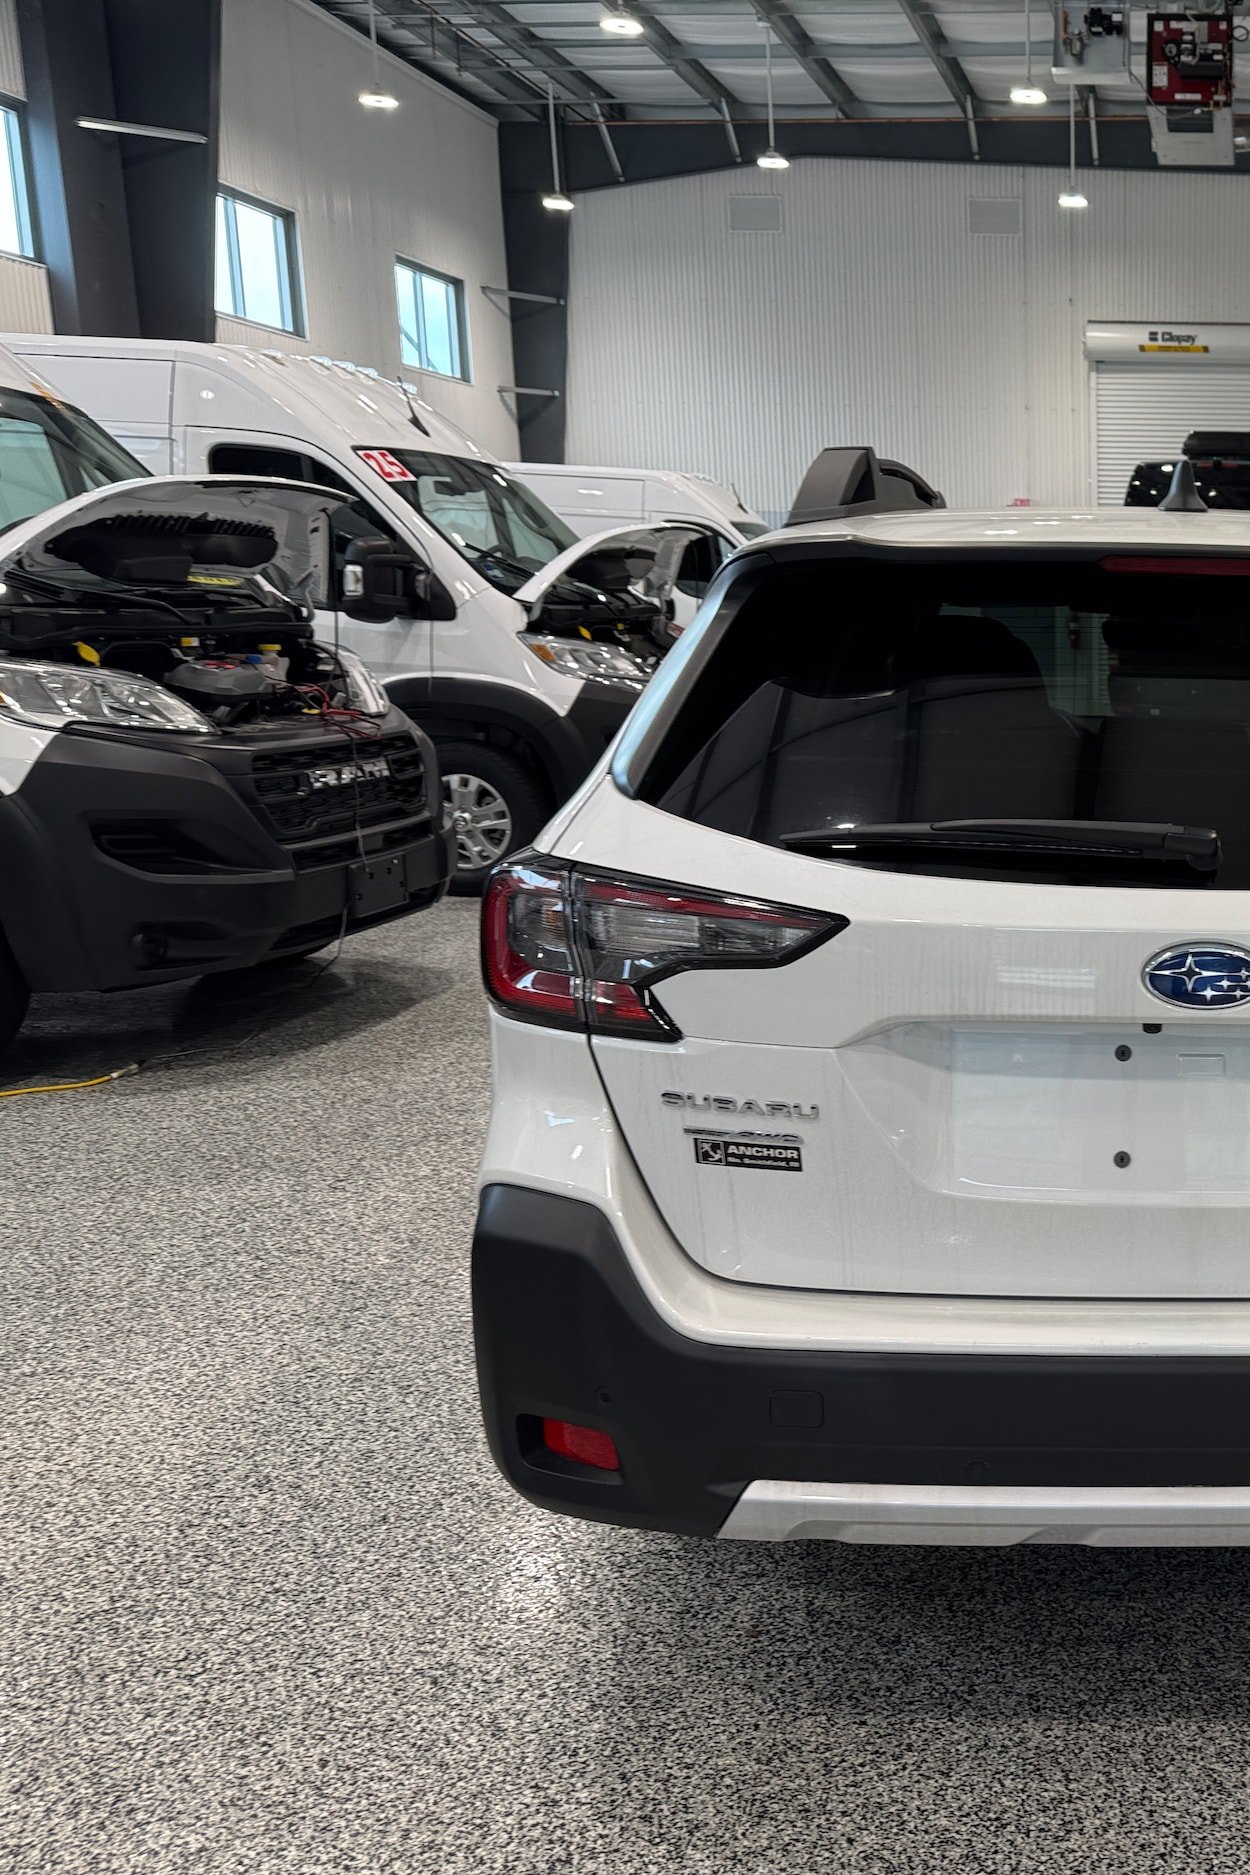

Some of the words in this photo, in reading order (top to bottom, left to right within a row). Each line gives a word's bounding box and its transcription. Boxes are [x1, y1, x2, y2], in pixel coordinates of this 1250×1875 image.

[1161, 331, 1198, 345] Clopay
[362, 451, 410, 479] 25
[304, 758, 390, 789] RAM
[661, 1089, 820, 1120] SUBARU
[727, 1145, 799, 1159] ANCHOR
